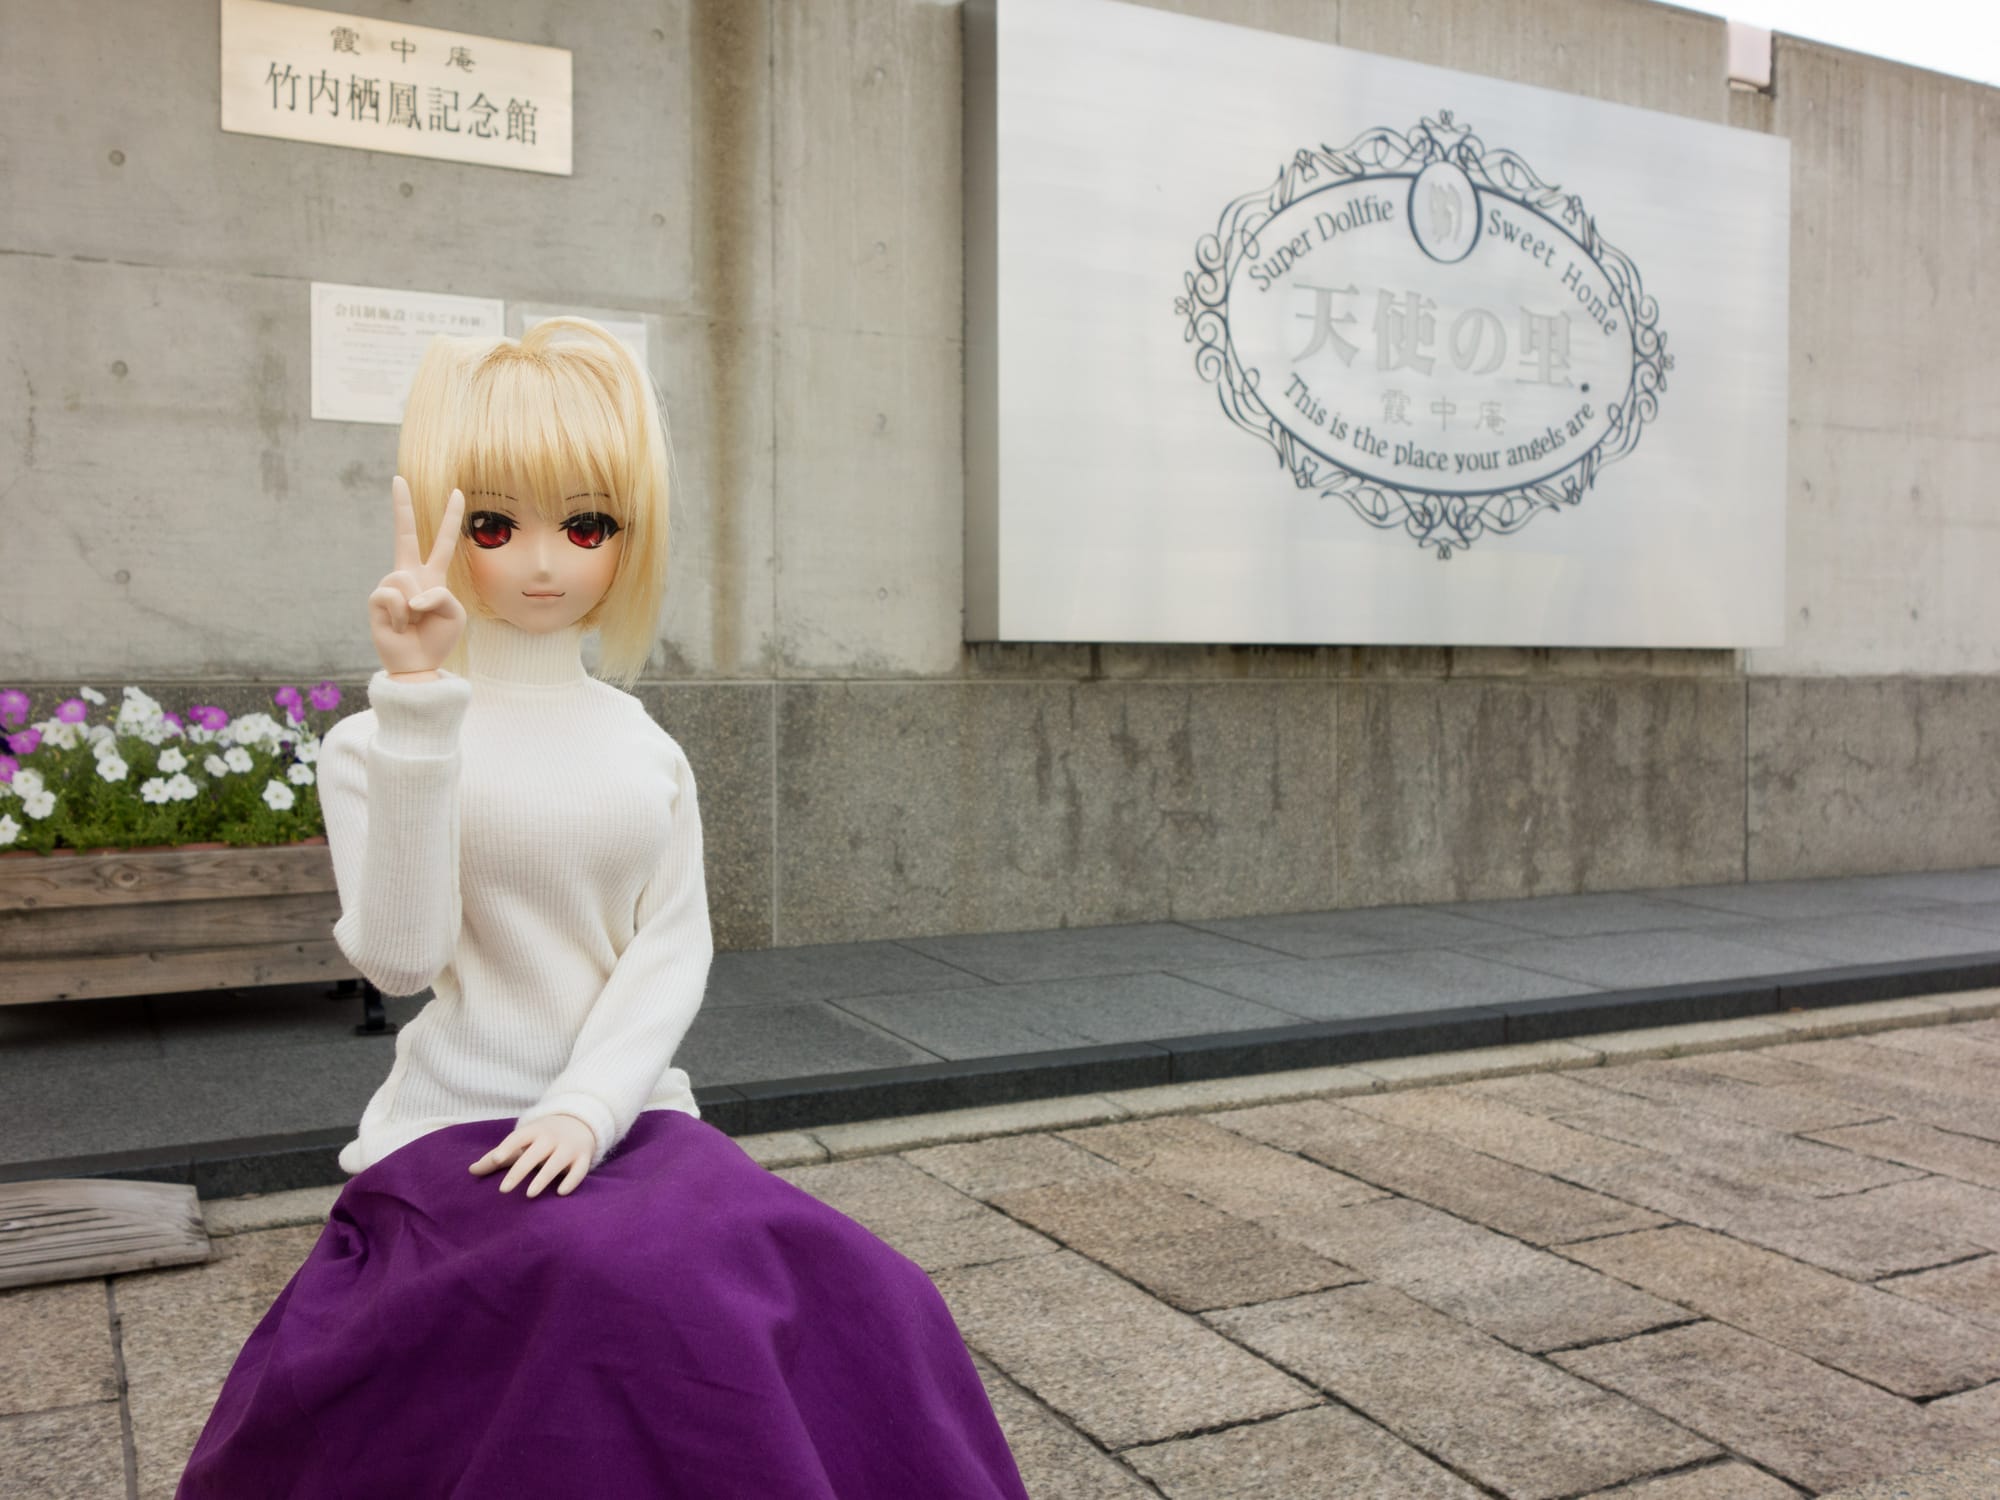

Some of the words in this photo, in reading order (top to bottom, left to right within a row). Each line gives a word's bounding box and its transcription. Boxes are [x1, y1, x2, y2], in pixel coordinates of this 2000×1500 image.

[264, 61, 538, 145] 竹内栖鳳記念館
[1248, 229, 1312, 292] Super
[1314, 194, 1394, 242] Dollfie
[1488, 209, 1556, 268] Sweet
[1561, 261, 1617, 336] Home
[1291, 283, 1574, 388] 天使の里
[1284, 372, 1328, 427] This
[1329, 412, 1348, 440] is
[1353, 427, 1389, 459] the
[1393, 441, 1449, 472] place
[1454, 449, 1500, 475] your
[1506, 426, 1566, 467] angels
